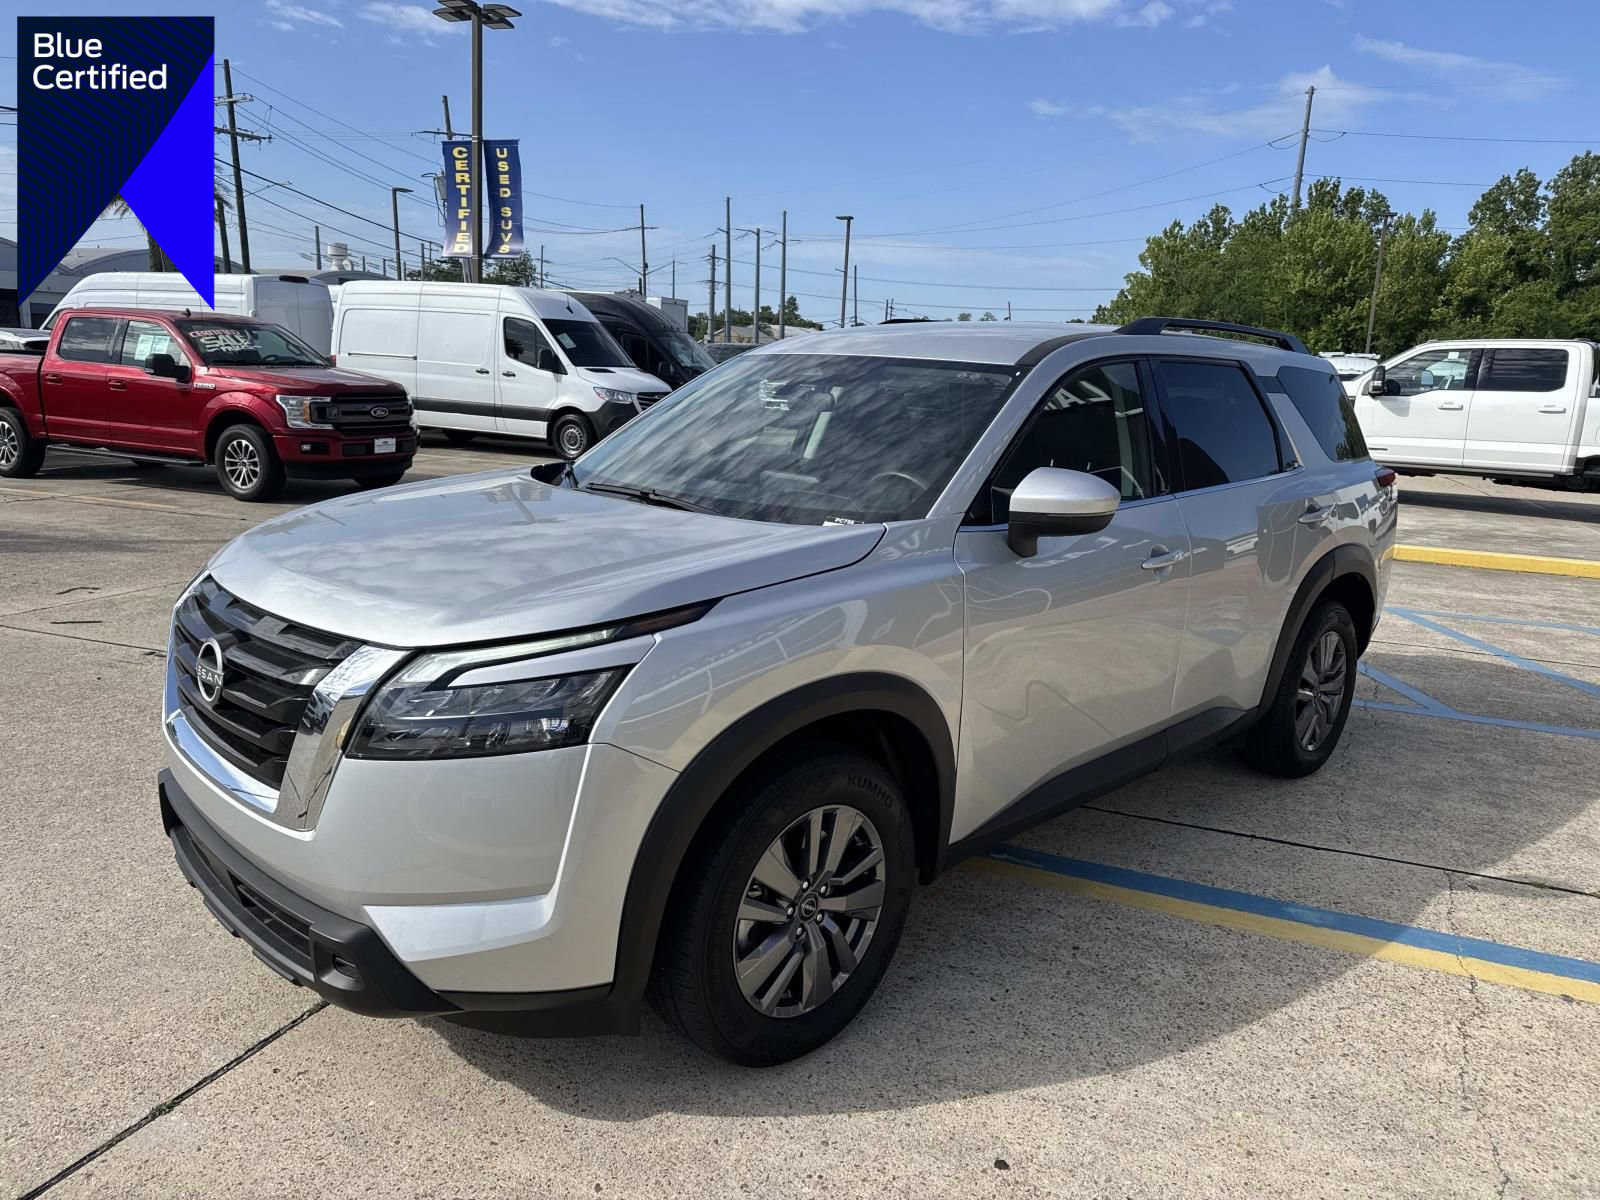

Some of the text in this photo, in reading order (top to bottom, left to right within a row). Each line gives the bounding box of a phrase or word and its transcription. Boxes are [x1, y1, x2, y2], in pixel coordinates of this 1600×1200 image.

[496, 147, 511, 198] USED
[452, 146, 470, 253] CERTIFIED
[847, 774, 893, 809] KUMHO
